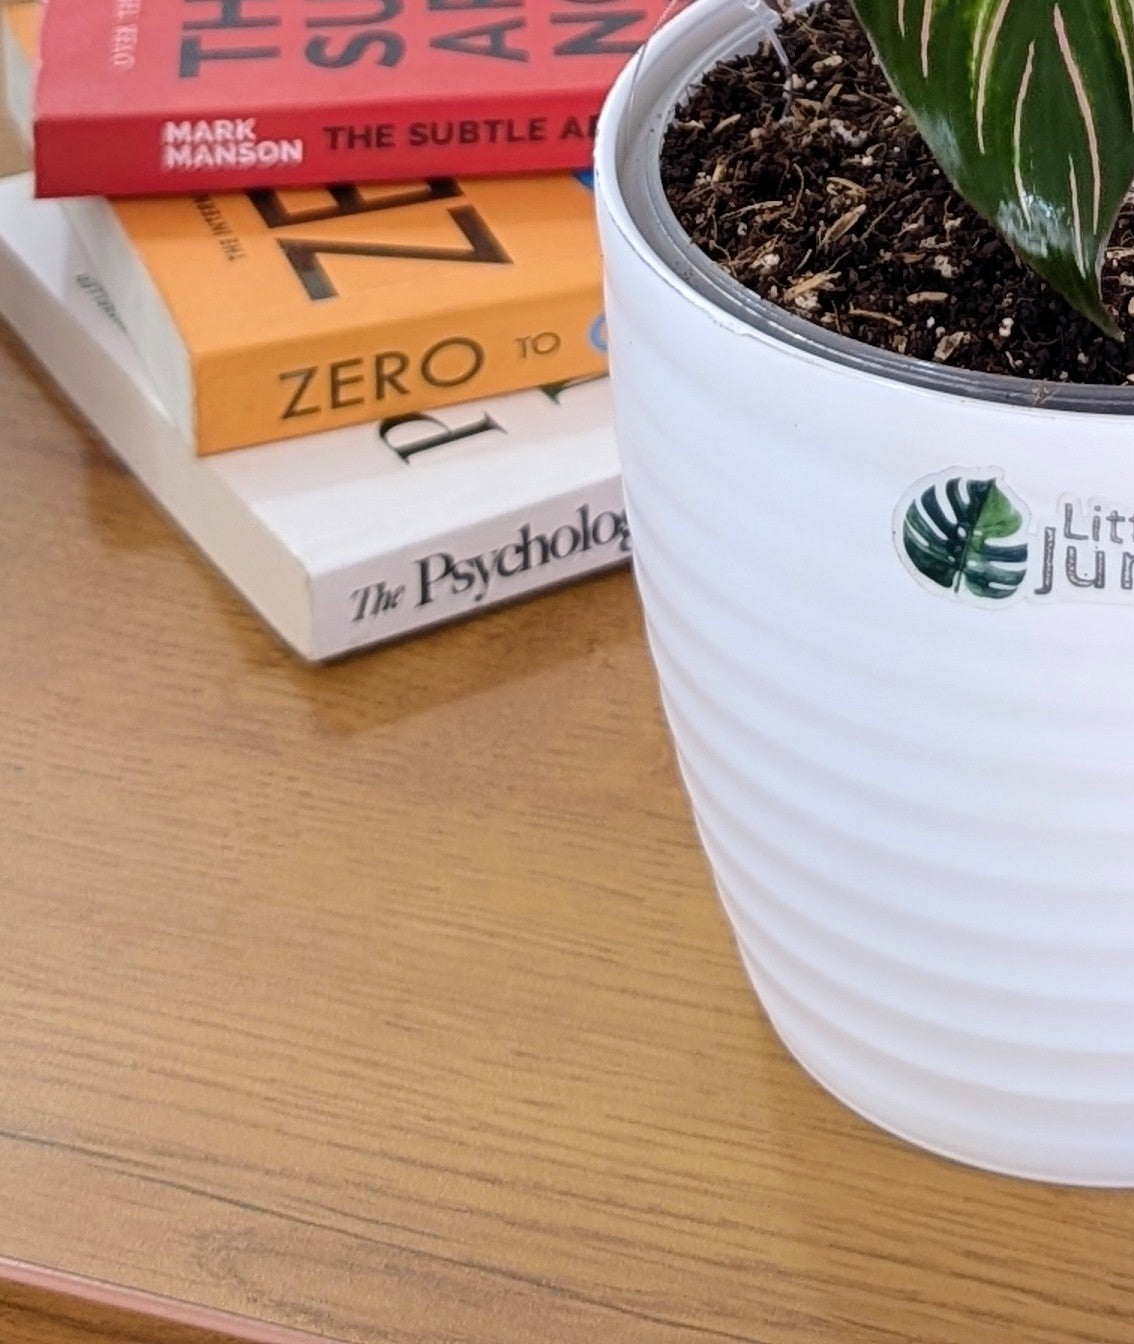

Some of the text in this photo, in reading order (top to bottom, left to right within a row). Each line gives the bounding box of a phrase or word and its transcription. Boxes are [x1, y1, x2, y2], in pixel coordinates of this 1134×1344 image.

[162, 117, 257, 145] MARK
[322, 123, 397, 151] THE
[408, 116, 548, 147] SUBTLE
[161, 138, 304, 171] MANSON
[279, 335, 485, 420] ZERO
[514, 330, 562, 359] TO
[350, 581, 406, 622] The
